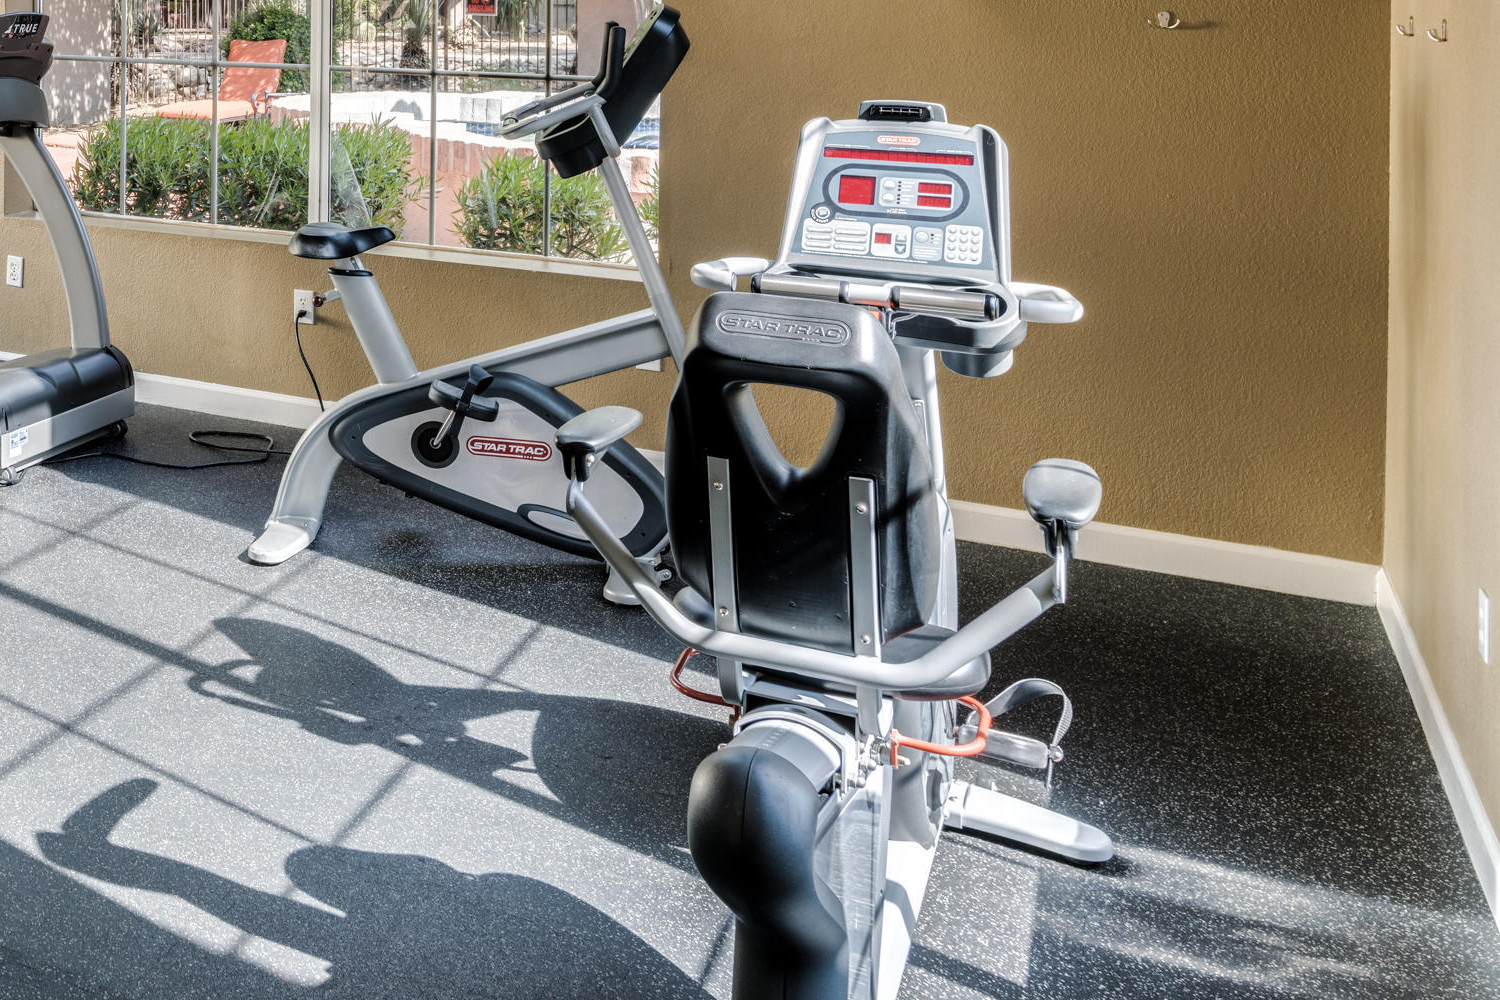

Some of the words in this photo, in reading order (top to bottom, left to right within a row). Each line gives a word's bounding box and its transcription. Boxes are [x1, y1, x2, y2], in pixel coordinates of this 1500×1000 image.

[14, 23, 38, 33] TRUE
[724, 317, 781, 332] STAR
[784, 323, 843, 339] TRAC
[473, 441, 506, 452] STAR
[508, 445, 545, 455] TRAC
